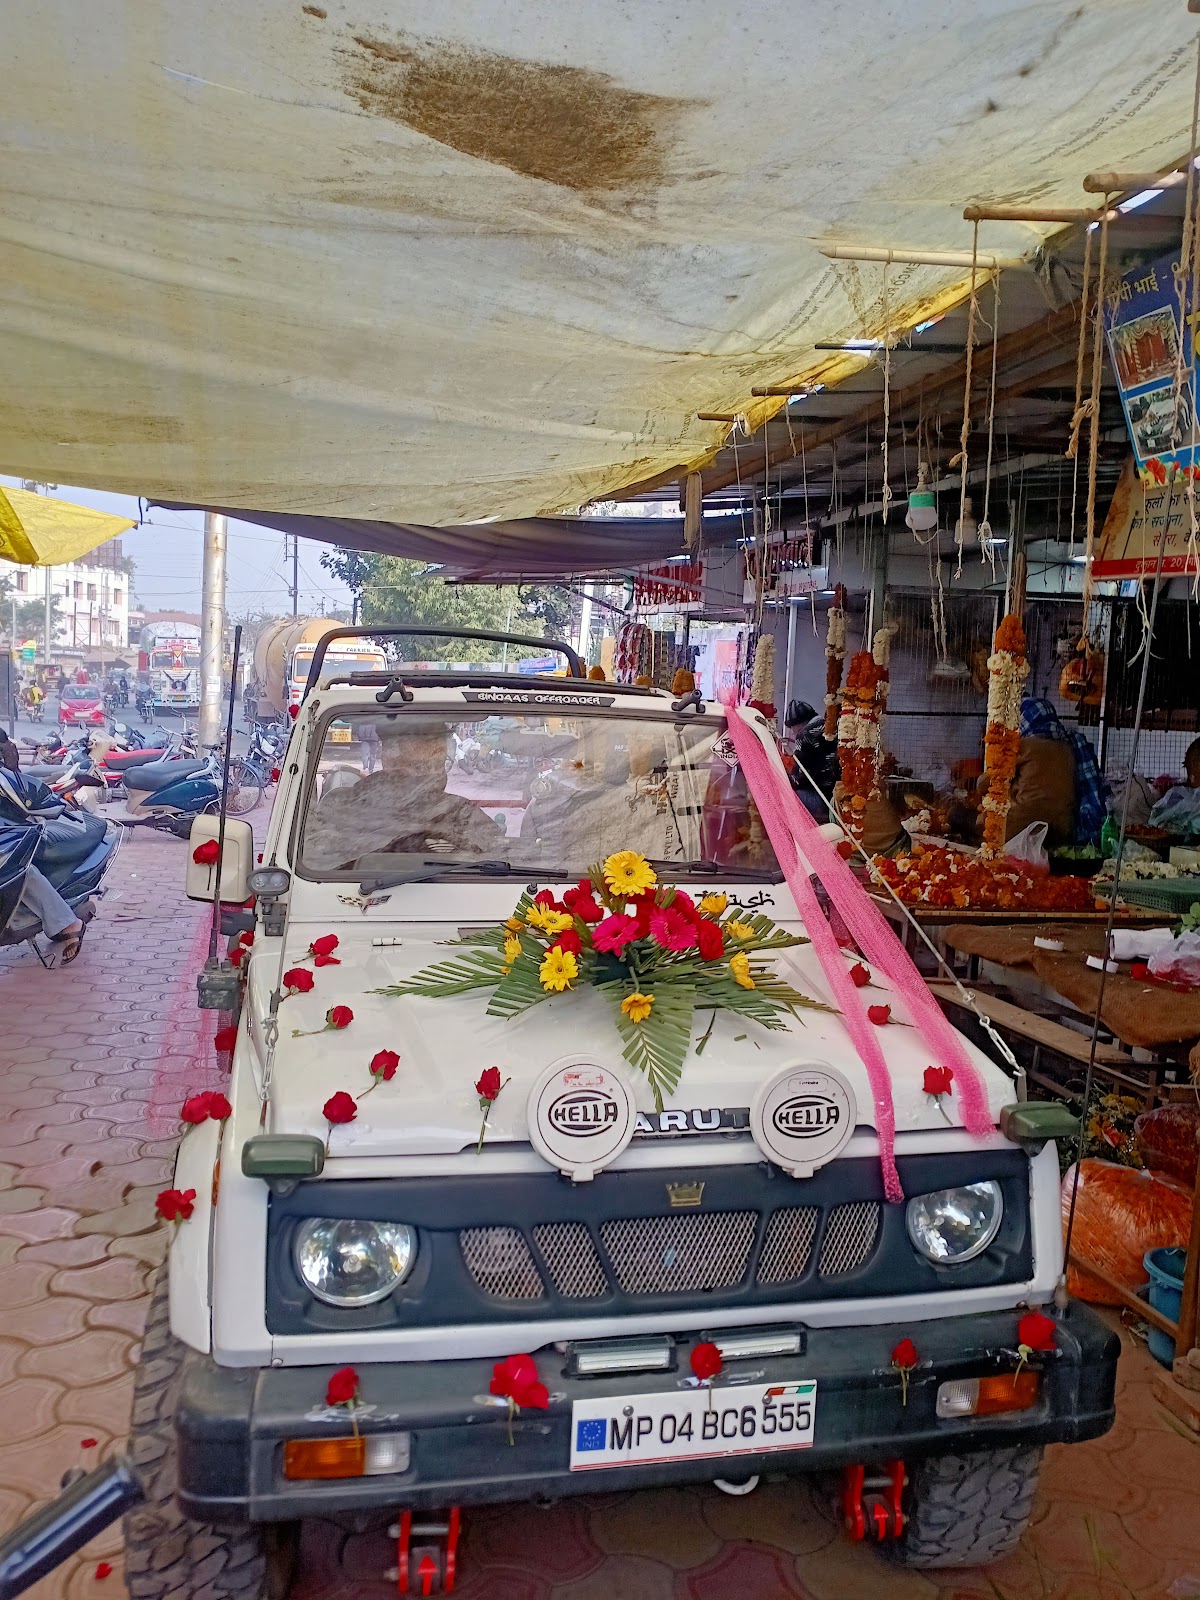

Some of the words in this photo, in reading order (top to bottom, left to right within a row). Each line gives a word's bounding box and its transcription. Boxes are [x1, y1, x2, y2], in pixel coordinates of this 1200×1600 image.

[554, 1101, 619, 1126] HELLA
[633, 1107, 750, 1133] ARUT
[777, 1105, 840, 1127] HELLA
